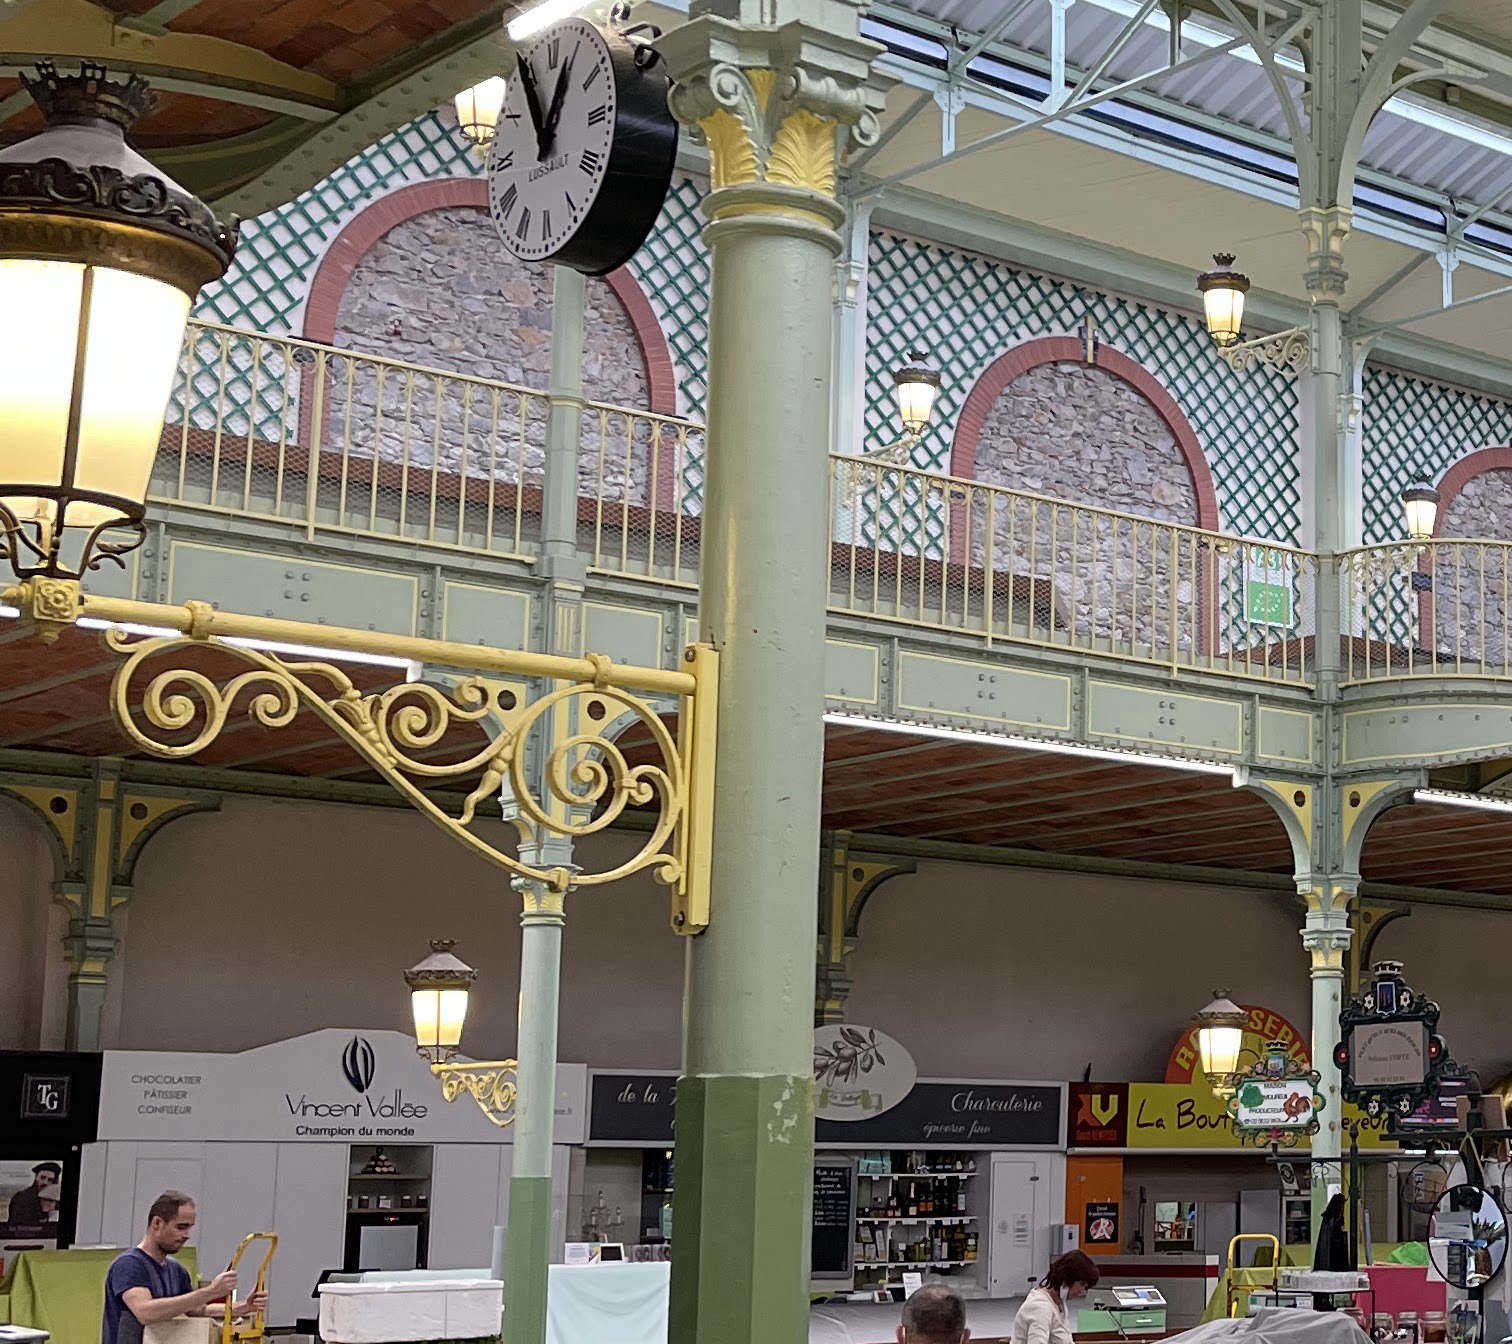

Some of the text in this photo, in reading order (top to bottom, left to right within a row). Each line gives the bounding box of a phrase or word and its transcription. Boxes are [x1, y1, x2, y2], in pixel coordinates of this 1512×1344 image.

[528, 153, 571, 183] LUSSAULT
[131, 1074, 202, 1086] CHOCOLATIER
[143, 1087, 188, 1101] PÂTISSIER
[617, 1082, 660, 1105] de la
[951, 1091, 1045, 1114] Charcuterie
[137, 1104, 192, 1115] CONFISEUR
[284, 1092, 362, 1120] Vincent
[1136, 1098, 1165, 1130] La
[295, 1124, 415, 1138] Champion du monde
